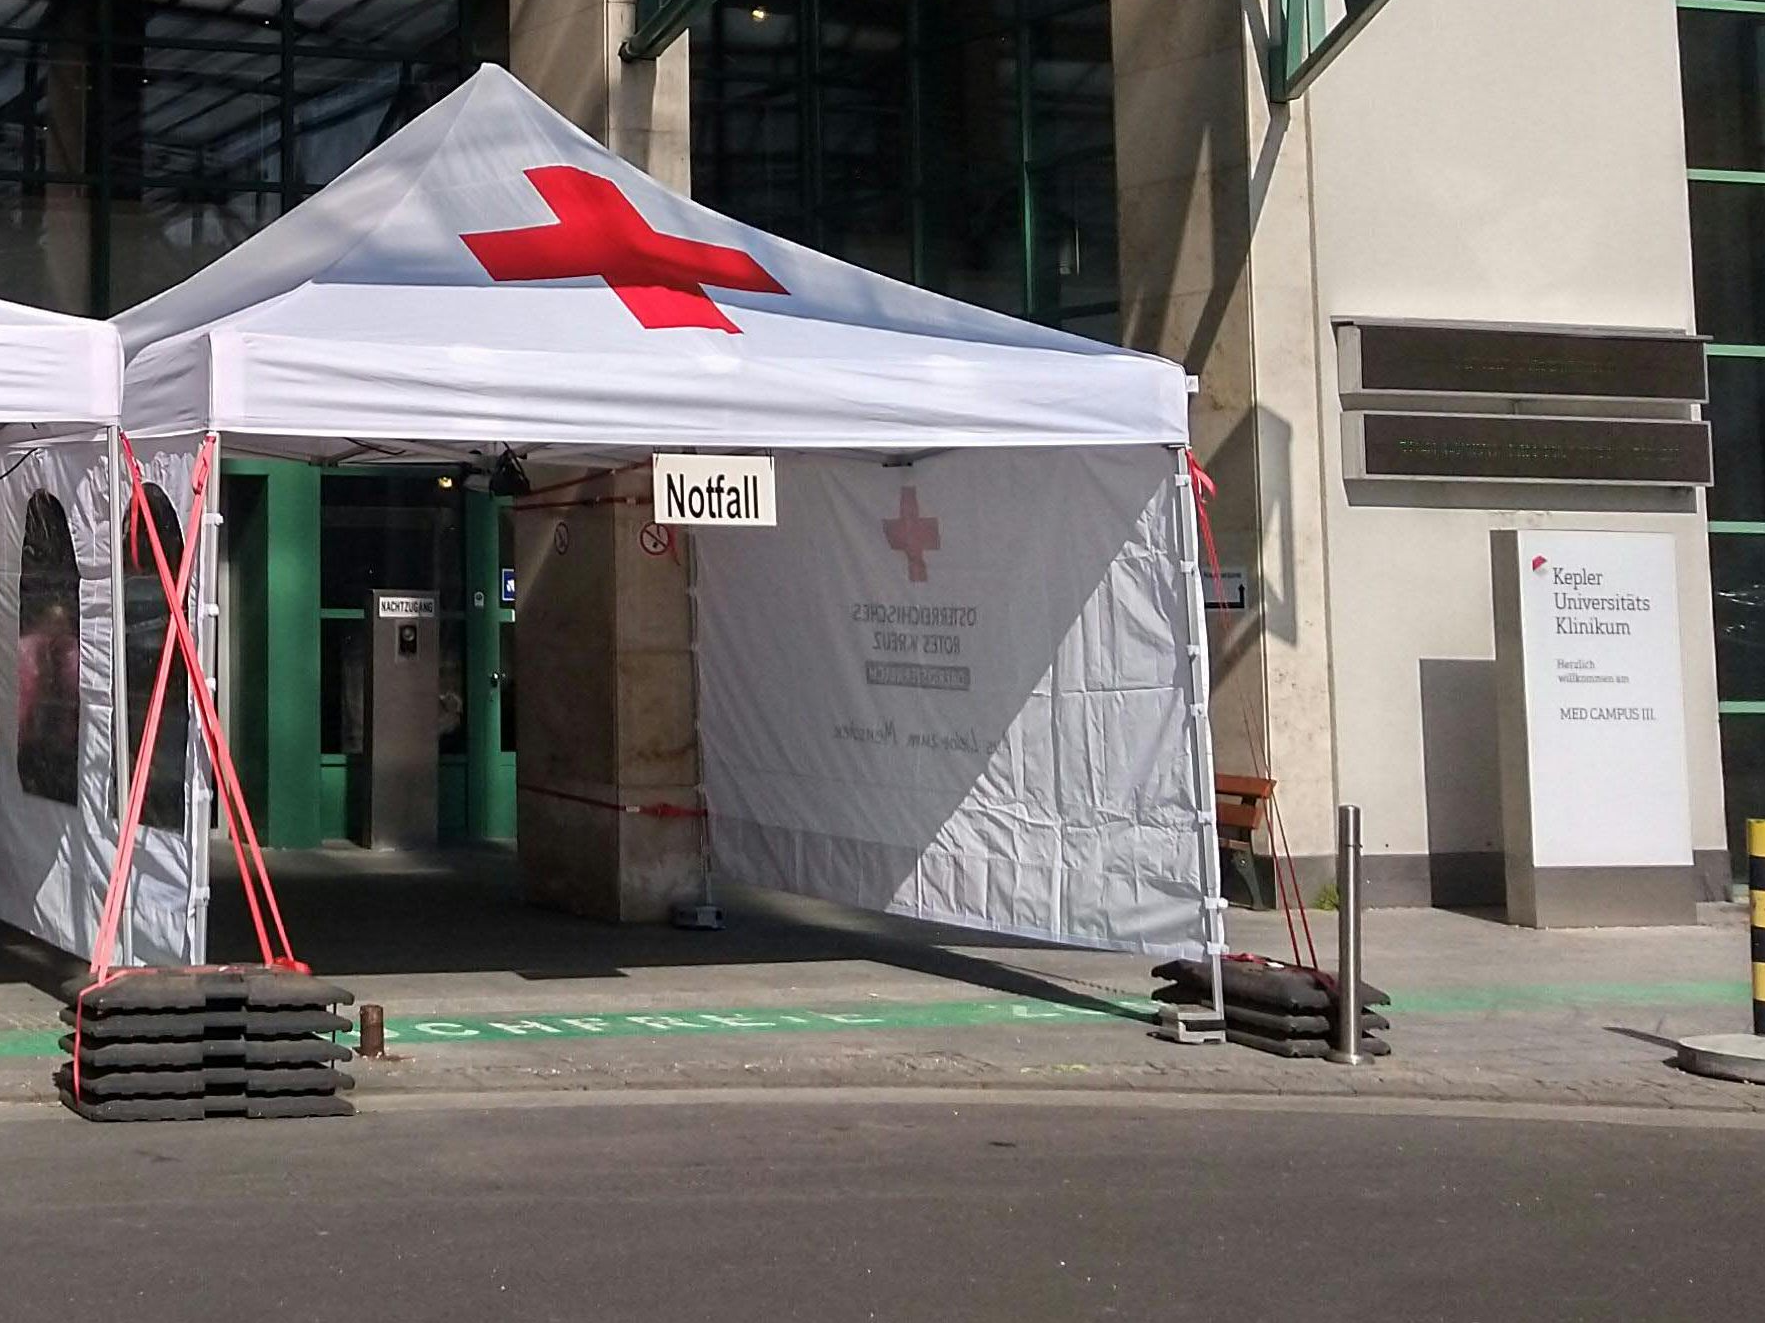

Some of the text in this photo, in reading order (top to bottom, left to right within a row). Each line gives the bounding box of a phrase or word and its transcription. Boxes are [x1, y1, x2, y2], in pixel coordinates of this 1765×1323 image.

[667, 473, 759, 519] Notfall
[1553, 567, 1603, 590] Kepler
[381, 601, 434, 613] NACHTZUGANG
[1554, 593, 1651, 611] Universitäts
[1556, 617, 1631, 636] Klinikum
[1557, 659, 1595, 669] Herzlich
[1560, 708, 1587, 720] MED
[1590, 708, 1639, 720] CAMPUS
